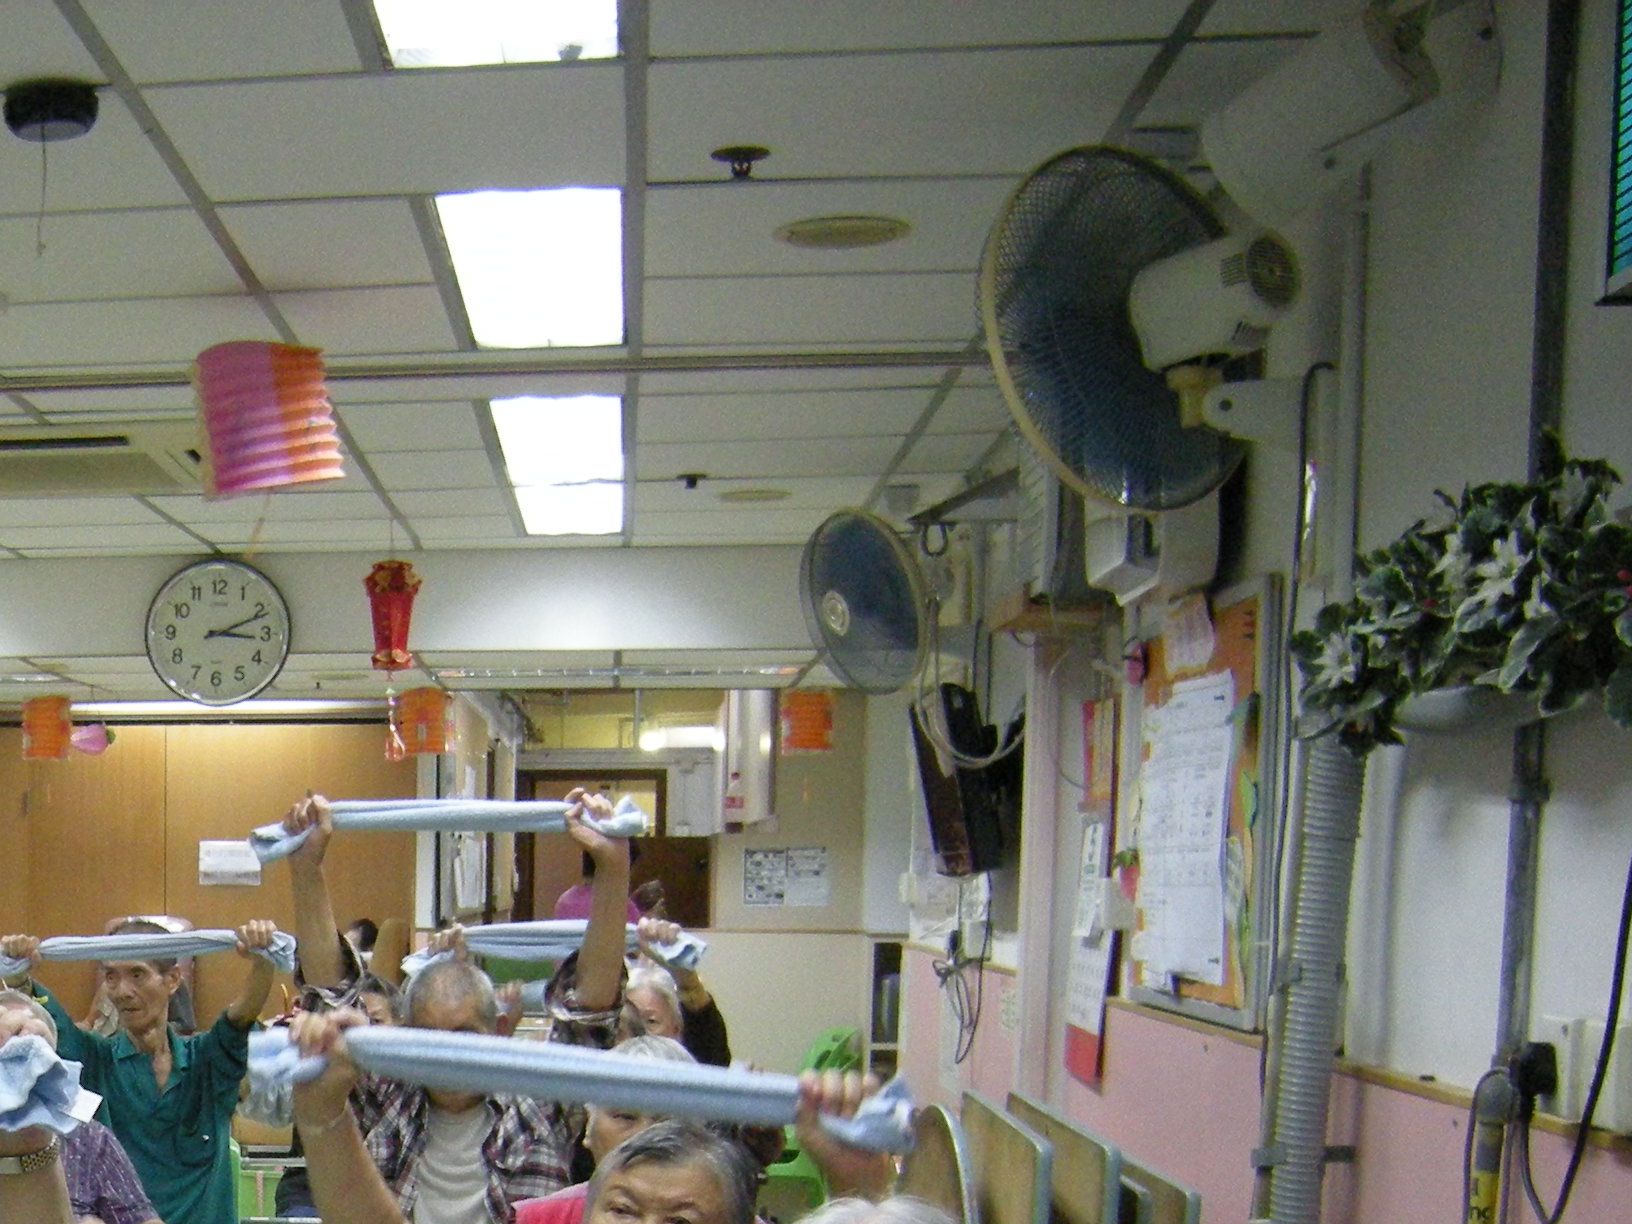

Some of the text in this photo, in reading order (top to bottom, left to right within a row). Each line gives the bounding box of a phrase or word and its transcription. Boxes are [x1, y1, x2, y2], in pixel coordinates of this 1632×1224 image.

[190, 585, 202, 601] 11
[211, 579, 228, 595] 12
[239, 585, 246, 601] 1
[173, 602, 191, 619] 10
[254, 602, 269, 619] 2
[164, 624, 177, 641] 9
[259, 625, 272, 642] 3
[171, 647, 184, 665] 8
[251, 648, 263, 665] 4
[190, 665, 202, 680] 7
[210, 671, 223, 687] 6
[233, 665, 246, 682] 5
